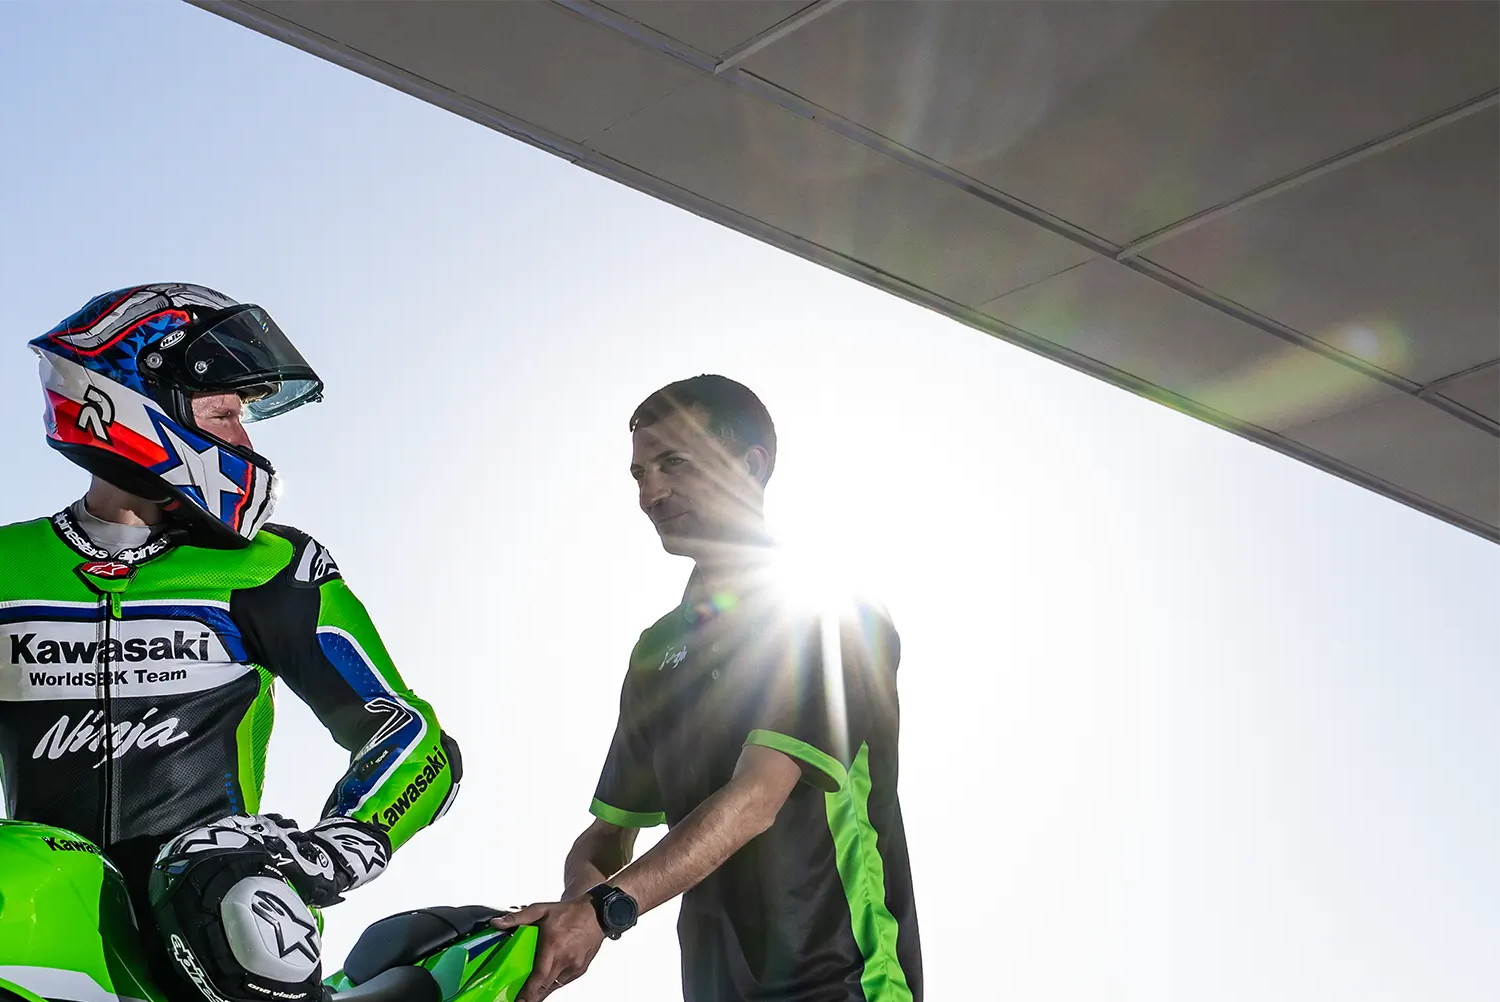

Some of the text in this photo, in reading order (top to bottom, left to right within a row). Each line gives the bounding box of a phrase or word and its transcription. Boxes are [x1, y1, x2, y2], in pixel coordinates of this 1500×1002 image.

[55, 512, 108, 559] alpinestars
[10, 630, 210, 664] Kawasaki
[29, 669, 187, 687] WorldSBK Team
[32, 707, 190, 769] Ninja
[367, 745, 447, 833] Kawasaki
